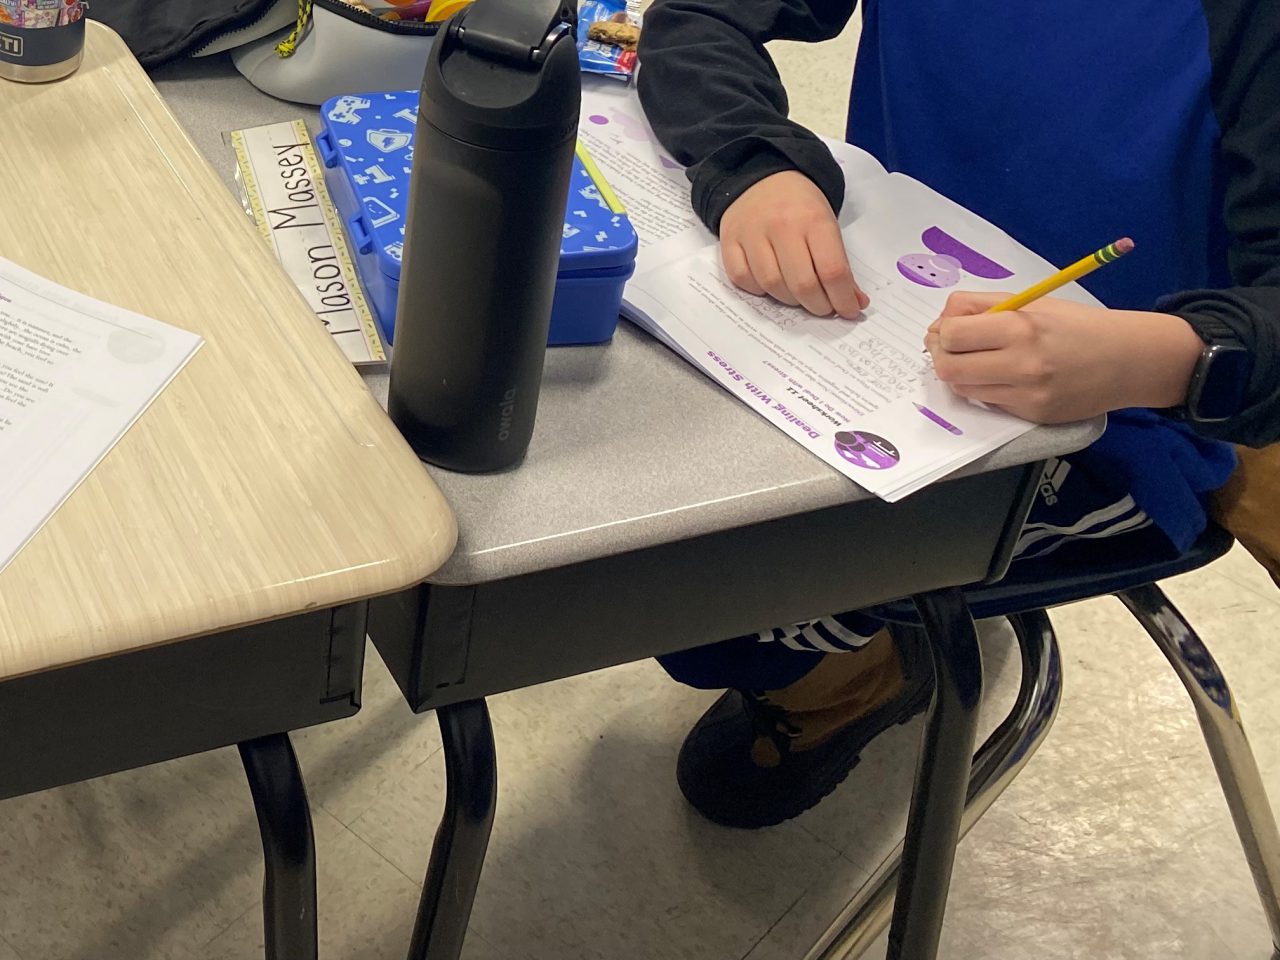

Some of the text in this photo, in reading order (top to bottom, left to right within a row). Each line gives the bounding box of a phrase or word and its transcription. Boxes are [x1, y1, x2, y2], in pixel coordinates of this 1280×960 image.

[267, 142, 324, 230] Massey
[707, 350, 821, 440] Dealing With Stress
[798, 395, 842, 427] Worksheet
